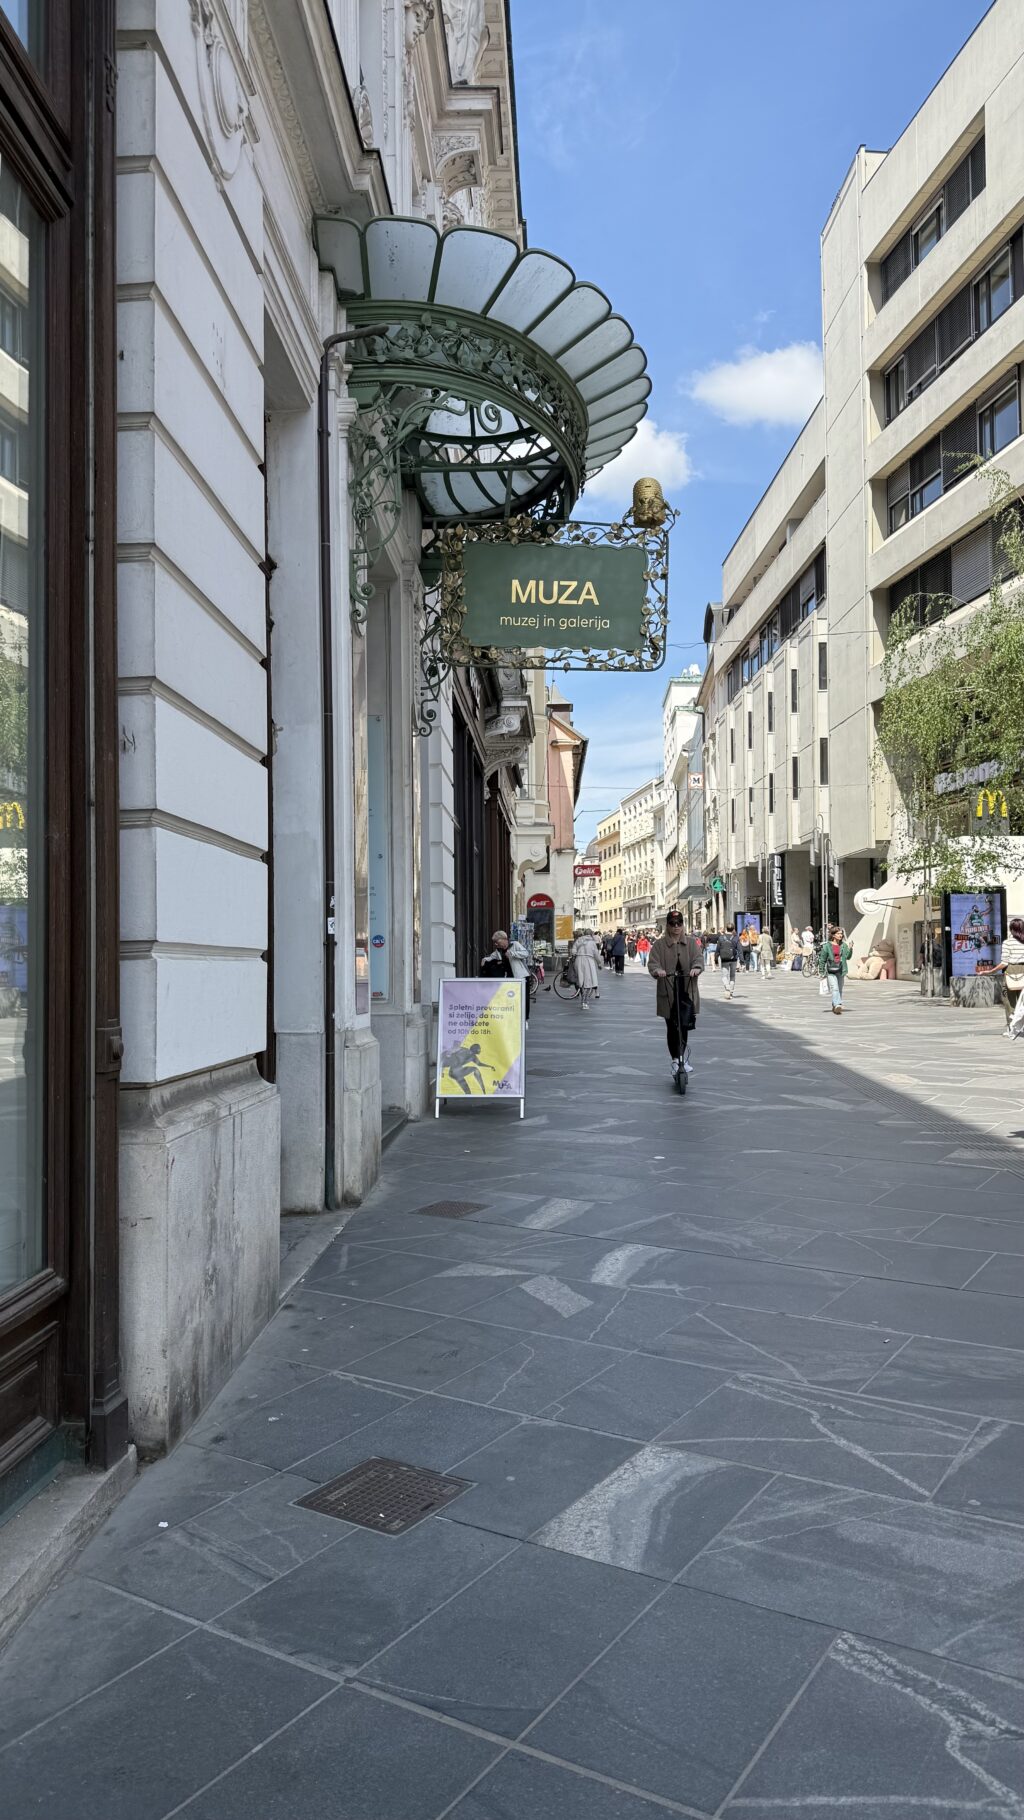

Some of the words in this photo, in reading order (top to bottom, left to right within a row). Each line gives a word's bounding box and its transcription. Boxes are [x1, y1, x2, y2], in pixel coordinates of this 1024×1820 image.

[511, 579, 600, 606] MUZA
[500, 614, 539, 629] muzej
[543, 614, 555, 627] in
[559, 615, 610, 631] galerija
